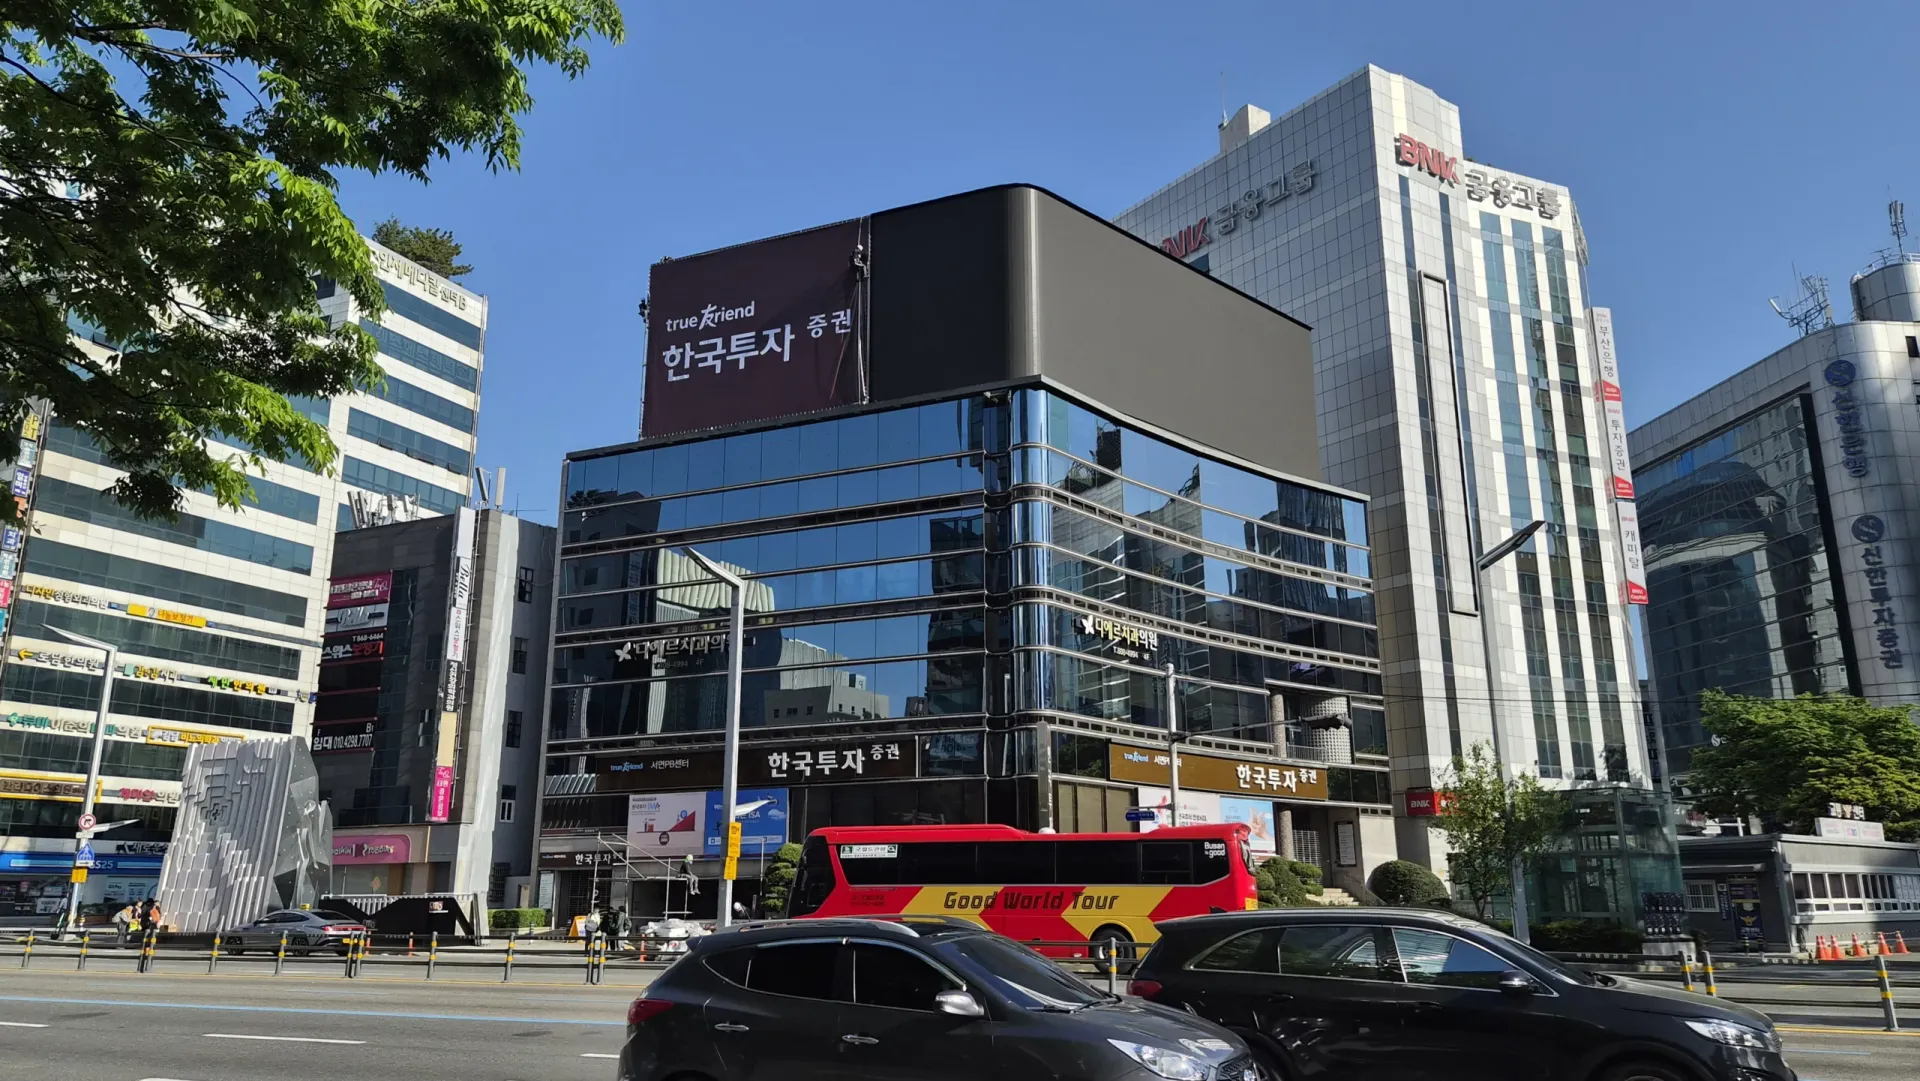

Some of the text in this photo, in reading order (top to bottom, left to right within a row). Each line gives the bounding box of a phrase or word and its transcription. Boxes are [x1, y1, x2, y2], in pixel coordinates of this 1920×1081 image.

[1400, 132, 1561, 220] BNK 금융그룹
[1161, 159, 1317, 259] NK 금융그룹
[663, 309, 851, 382] 한국투자 증권
[1600, 326, 1613, 377] 부산은행
[1612, 419, 1626, 471] 투자증권
[1831, 388, 1868, 478] 신한은행
[1625, 530, 1640, 569] 캐피탈
[1861, 545, 1903, 669] 신한투자증권
[1095, 617, 1158, 652] 디에르치과의원
[313, 736, 333, 750] 임대
[767, 743, 900, 777] 한국투자 증권
[651, 758, 689, 769] 서면PB센터
[1236, 764, 1318, 793] 한국투자 증권
[1410, 800, 1430, 808] BNK
[575, 853, 612, 866] 한국투자
[1204, 841, 1225, 849] Busan
[1209, 850, 1226, 859] good
[944, 890, 1120, 910] Good World Tour
